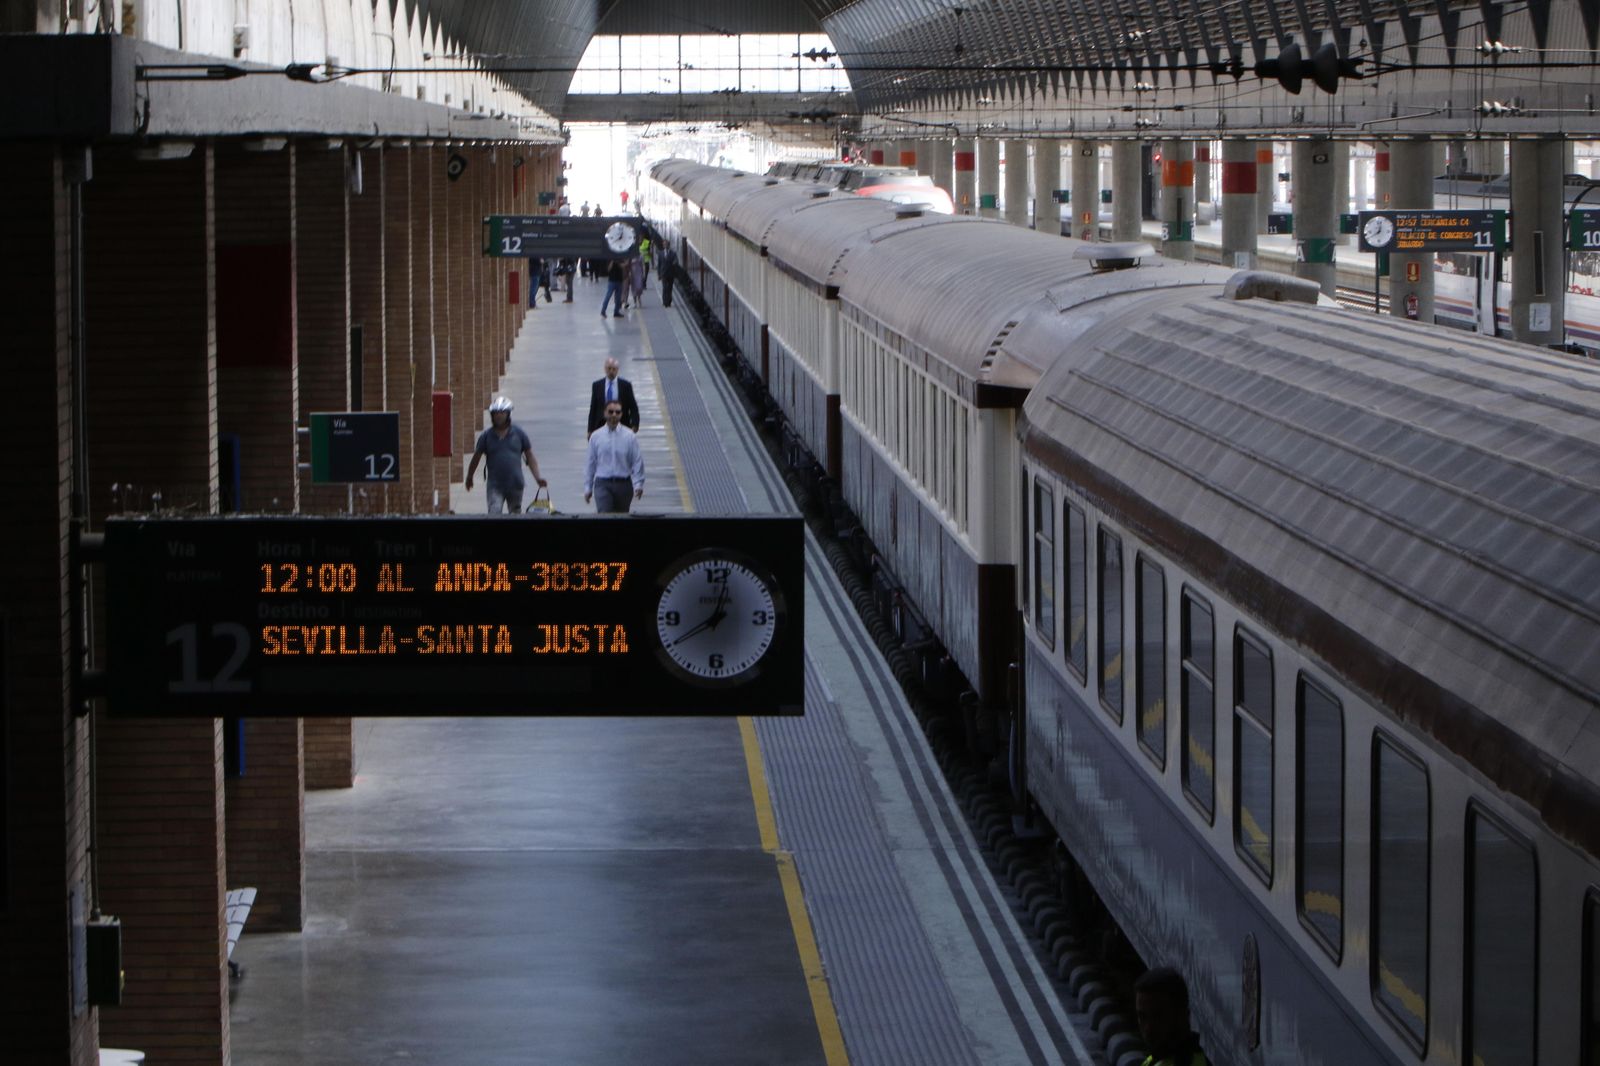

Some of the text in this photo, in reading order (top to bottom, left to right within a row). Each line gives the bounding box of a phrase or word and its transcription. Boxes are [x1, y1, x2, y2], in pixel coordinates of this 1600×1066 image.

[502, 236, 522, 254] 12
[1473, 231, 1494, 247] 11
[1583, 230, 1600, 247] 10
[1295, 245, 1306, 262] A
[364, 453, 396, 479] 12
[257, 540, 302, 558] Hora
[374, 540, 416, 558] Tren
[261, 562, 628, 593] 12:00 AL ANDA-38337
[257, 599, 330, 619] Destino
[752, 610, 767, 626] 3
[665, 611, 681, 627] 9
[261, 624, 630, 655] SEVILLA-SANTA JUSTA
[165, 621, 252, 694] 12
[708, 654, 724, 670] 6
